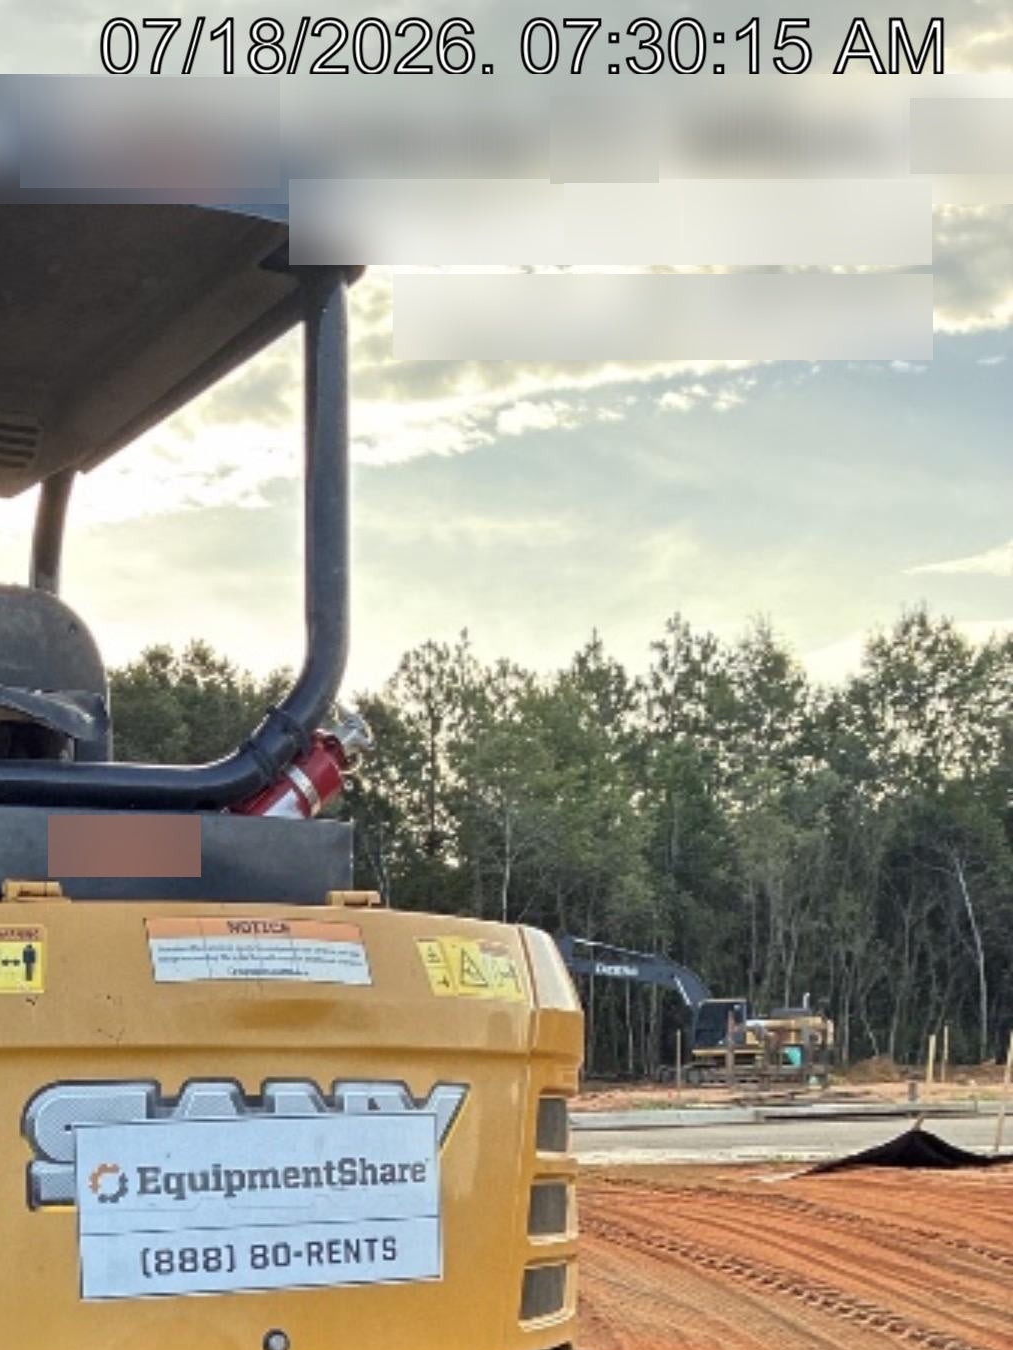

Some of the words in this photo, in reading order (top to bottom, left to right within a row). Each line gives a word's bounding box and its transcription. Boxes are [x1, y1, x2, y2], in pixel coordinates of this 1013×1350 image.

[135, 1156, 427, 1198] EquipmentShare
[140, 1244, 237, 1278] (888)
[250, 1236, 398, 1271] 80-RENTS
